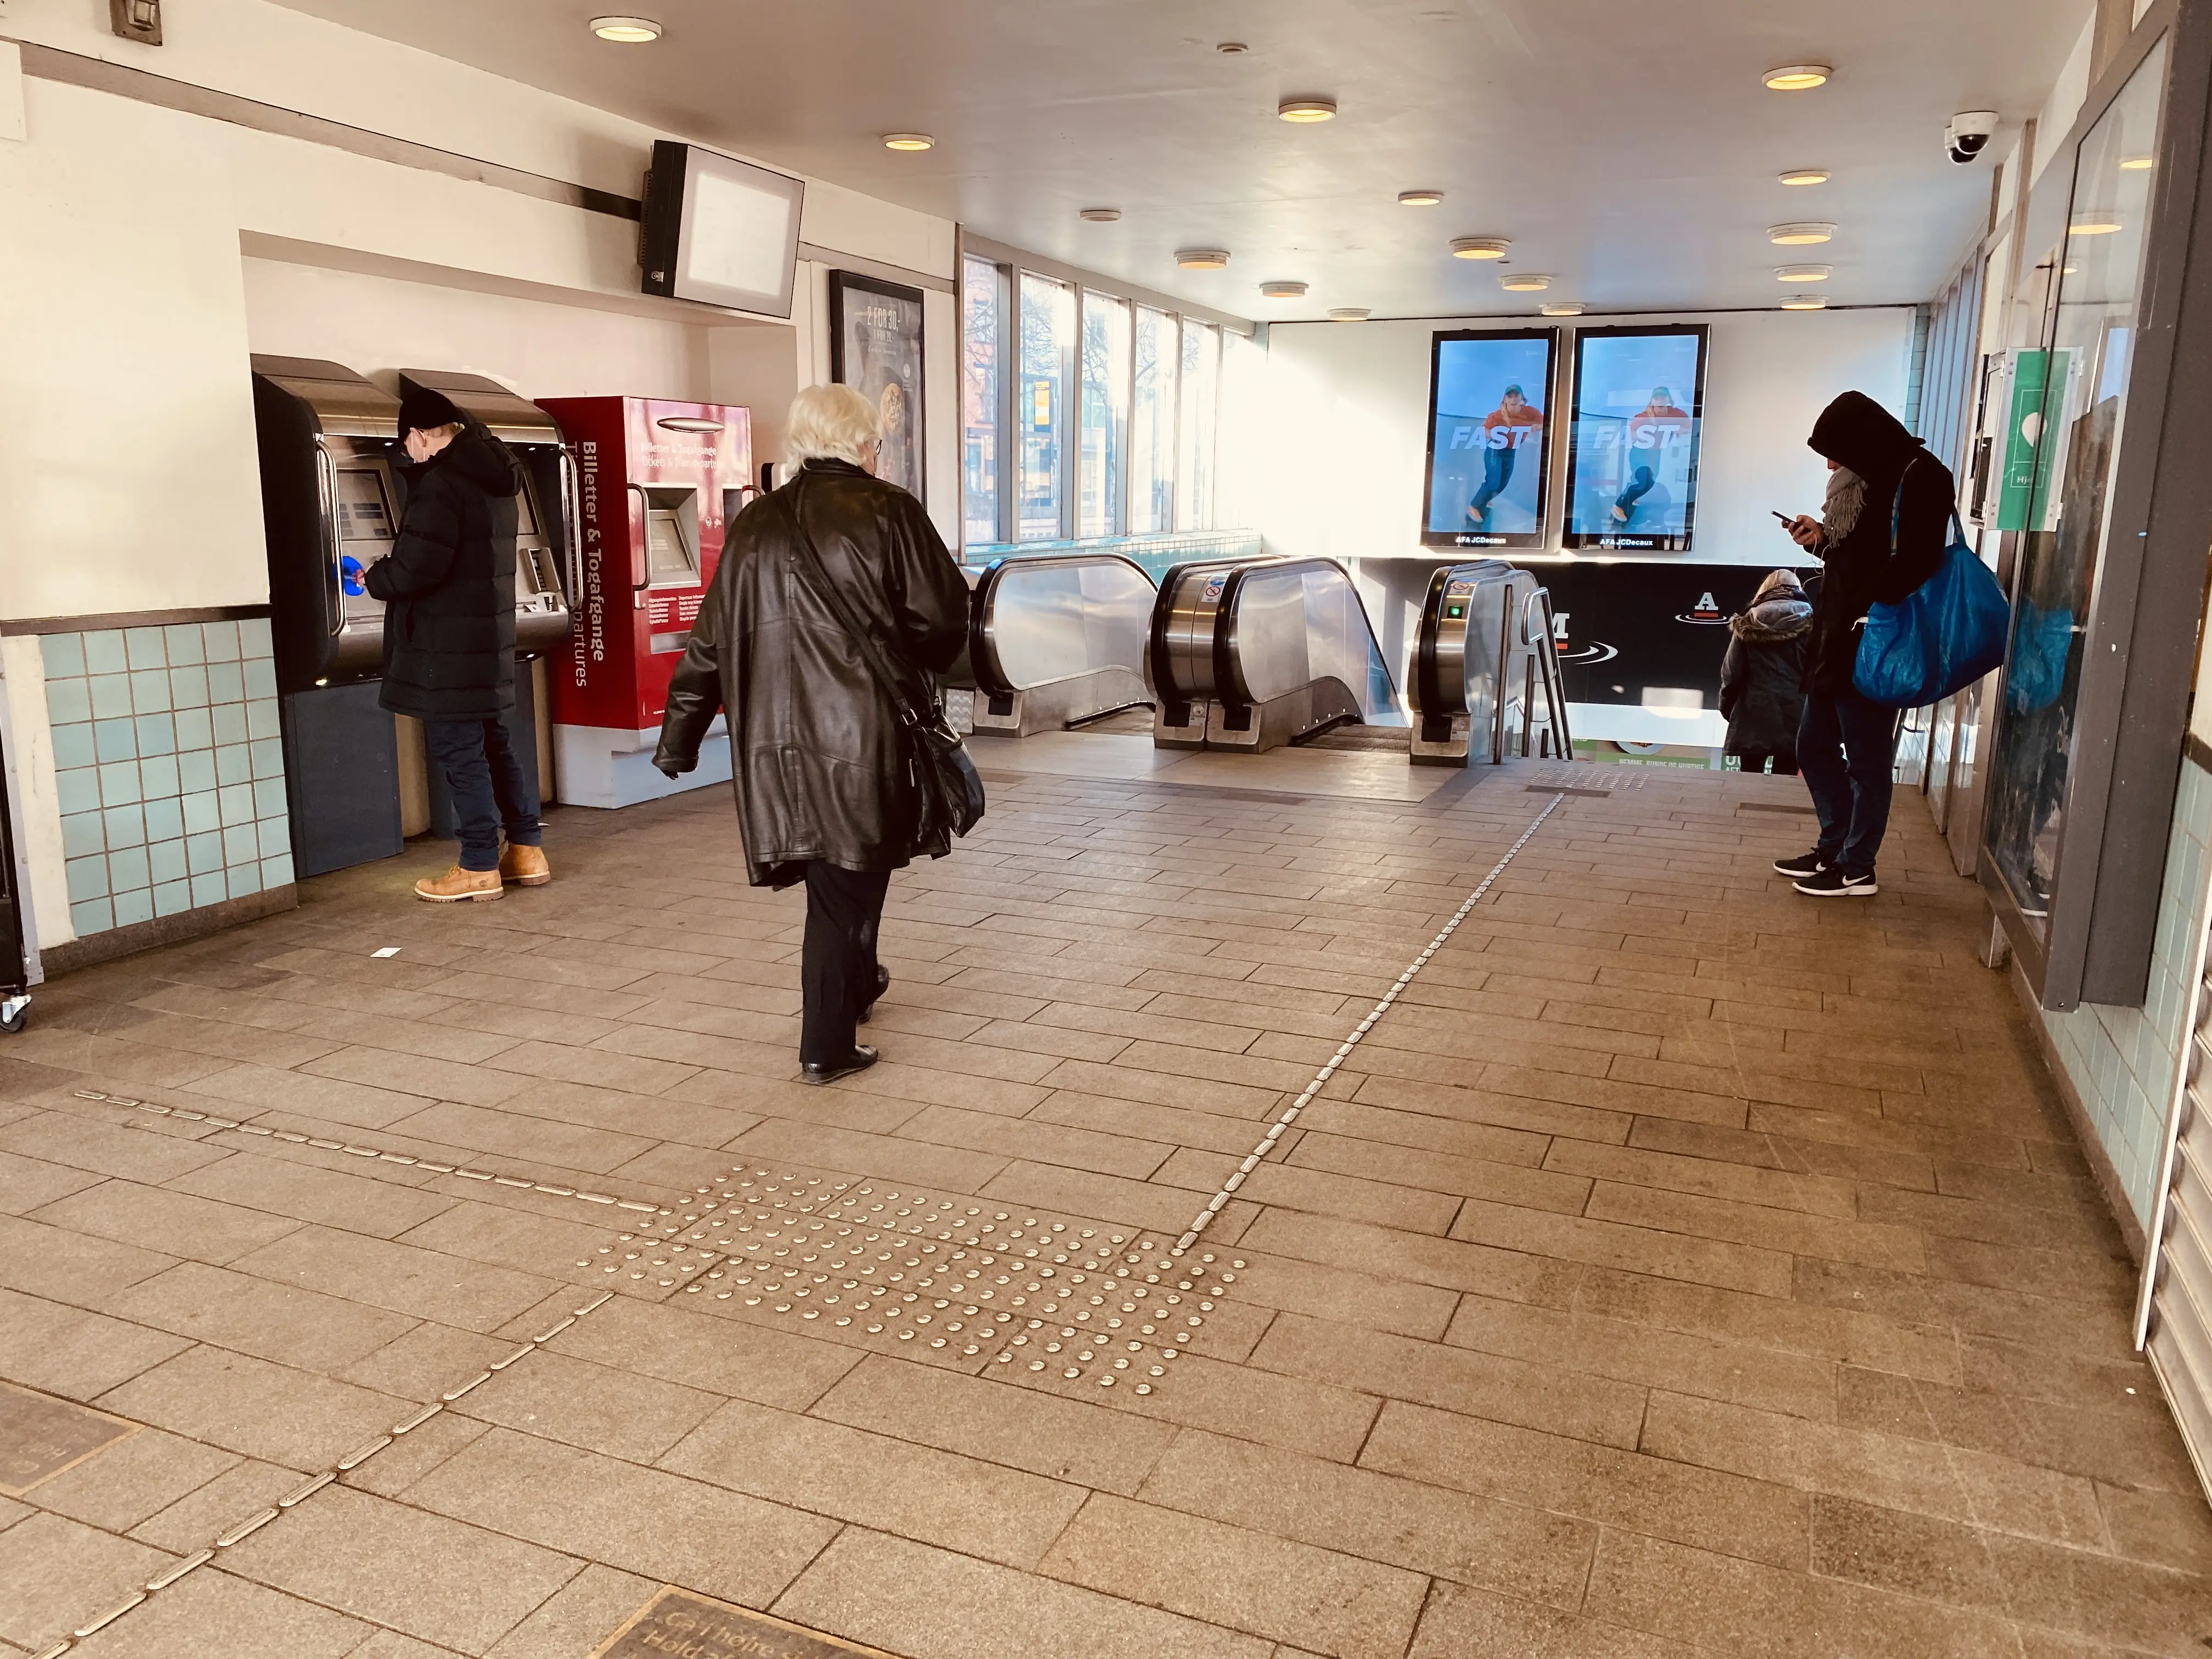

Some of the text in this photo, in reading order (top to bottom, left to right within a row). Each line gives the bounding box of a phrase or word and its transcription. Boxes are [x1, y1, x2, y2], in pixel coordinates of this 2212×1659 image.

[867, 306, 872, 326] 2
[874, 307, 887, 328] FOR
[1449, 425, 1532, 450] FAST
[1593, 425, 1680, 449] FAST
[583, 442, 605, 662] Billetter & Togafgange
[1695, 592, 1719, 611] A
